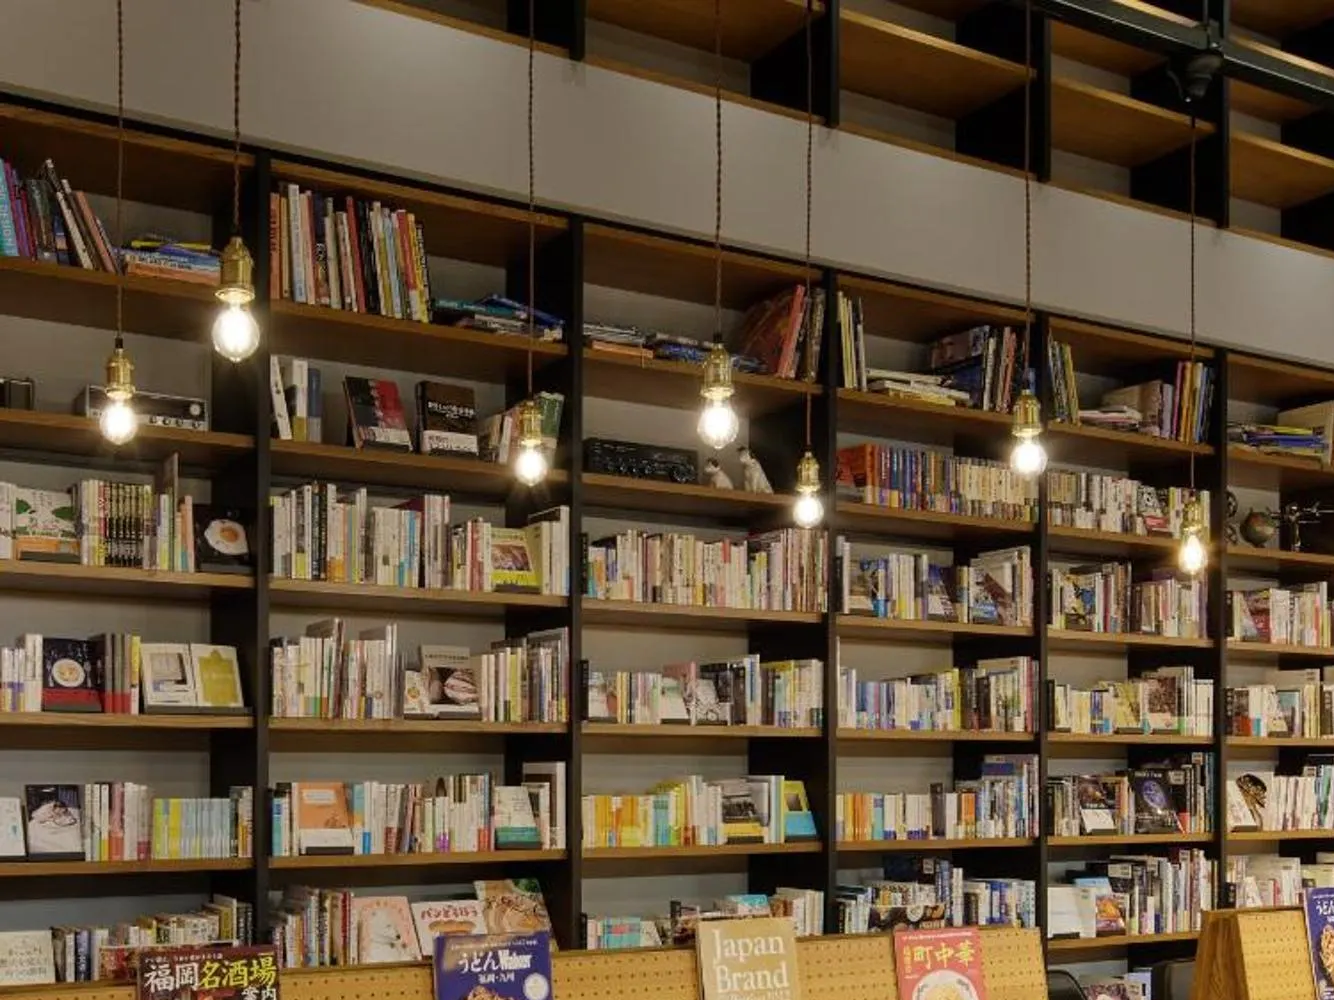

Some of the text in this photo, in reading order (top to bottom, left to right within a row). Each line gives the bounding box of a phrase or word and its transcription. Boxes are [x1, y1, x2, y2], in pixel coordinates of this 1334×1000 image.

[712, 929, 785, 969] Japan
[913, 940, 974, 970] 町中華
[144, 955, 277, 993] 福岡名酒場
[715, 961, 789, 993] Brand
